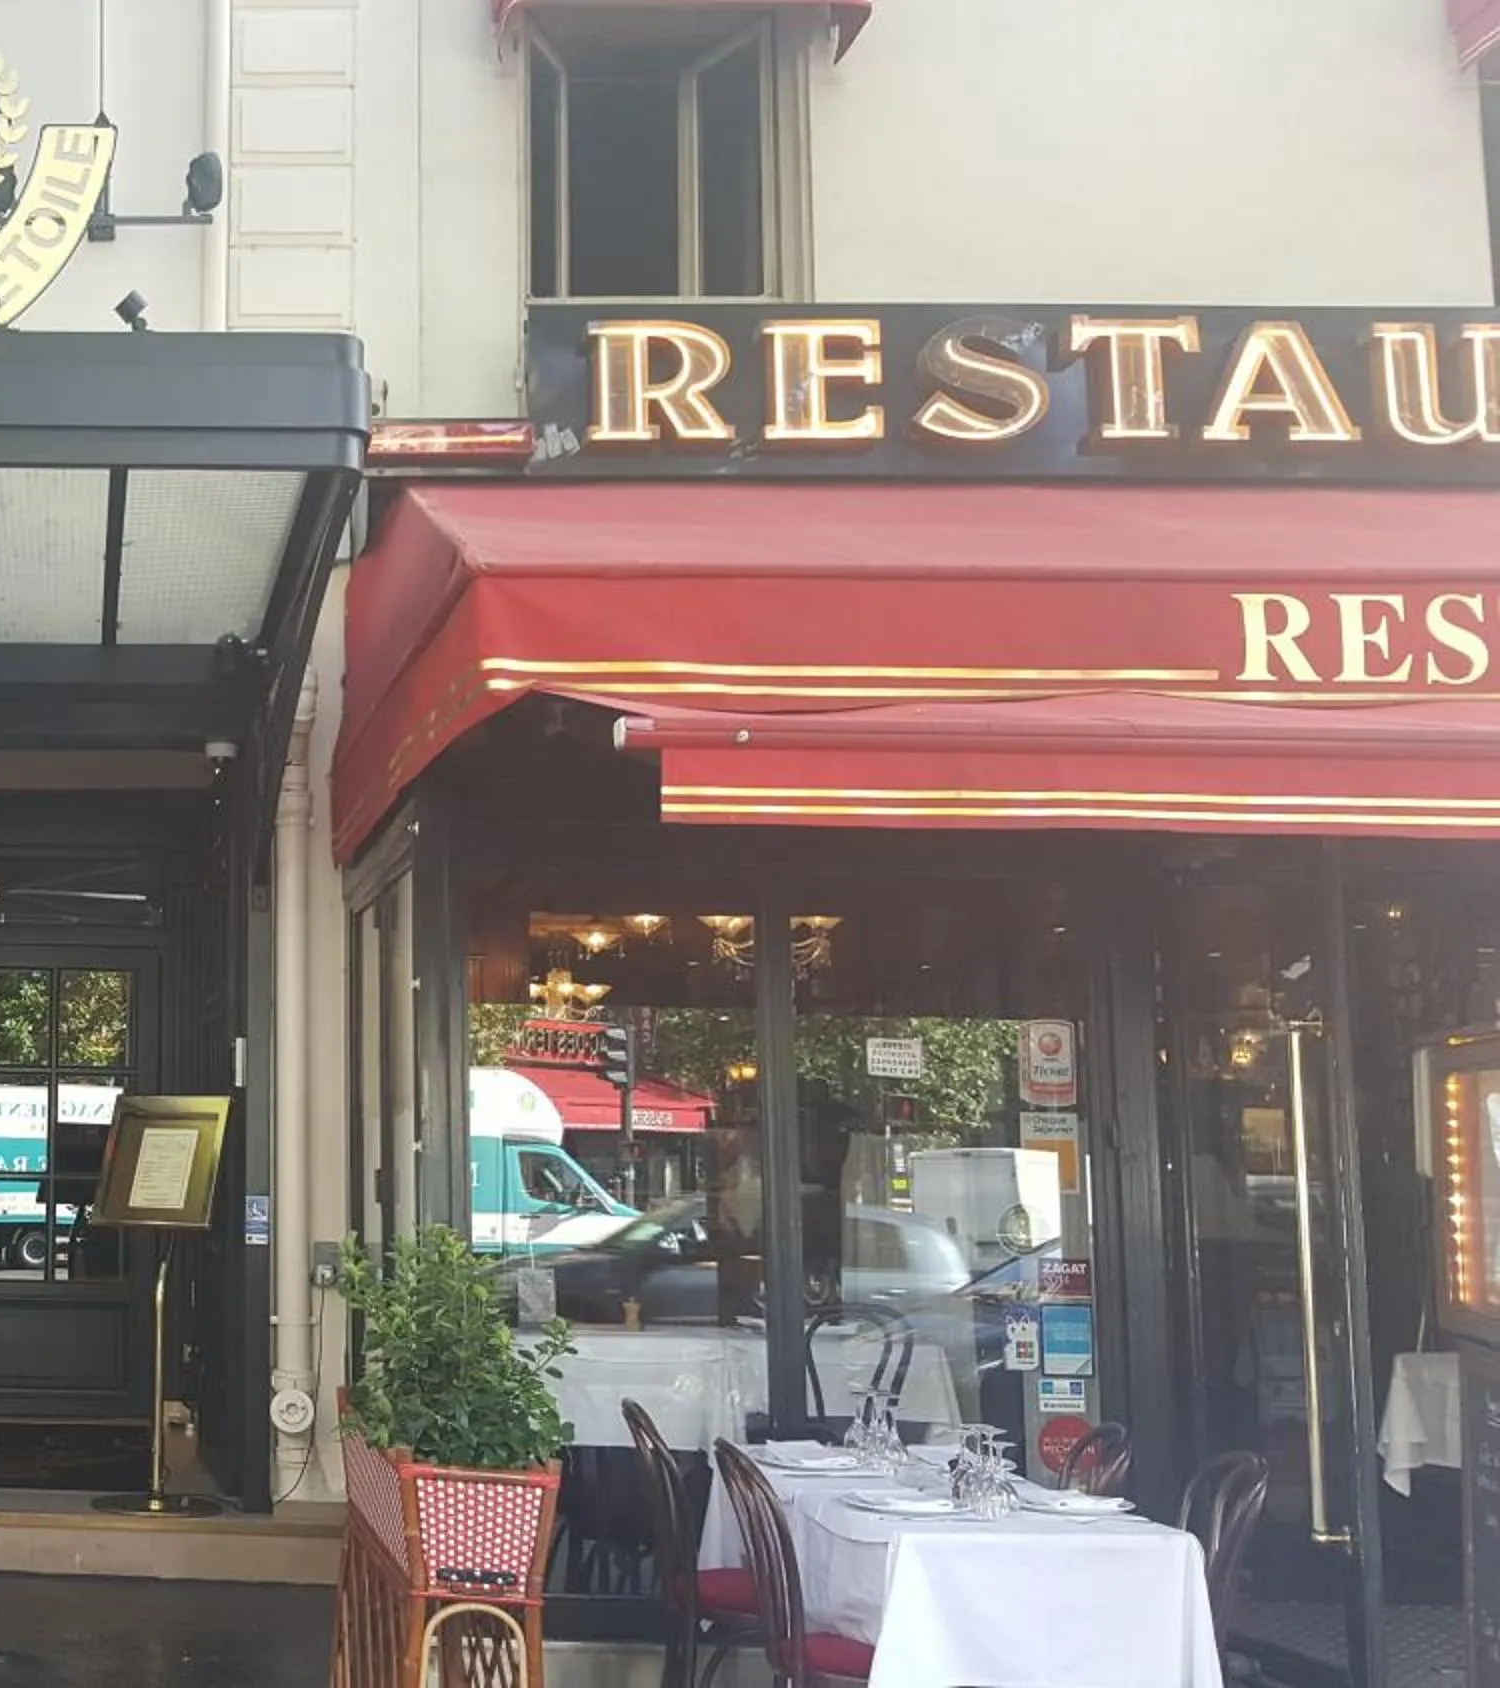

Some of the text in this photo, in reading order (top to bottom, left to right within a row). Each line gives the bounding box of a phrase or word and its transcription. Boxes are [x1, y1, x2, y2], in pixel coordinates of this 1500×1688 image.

[586, 314, 1500, 444] RESTAU
[1230, 592, 1489, 685] RES
[1042, 1263, 1087, 1274] ZAGAT
